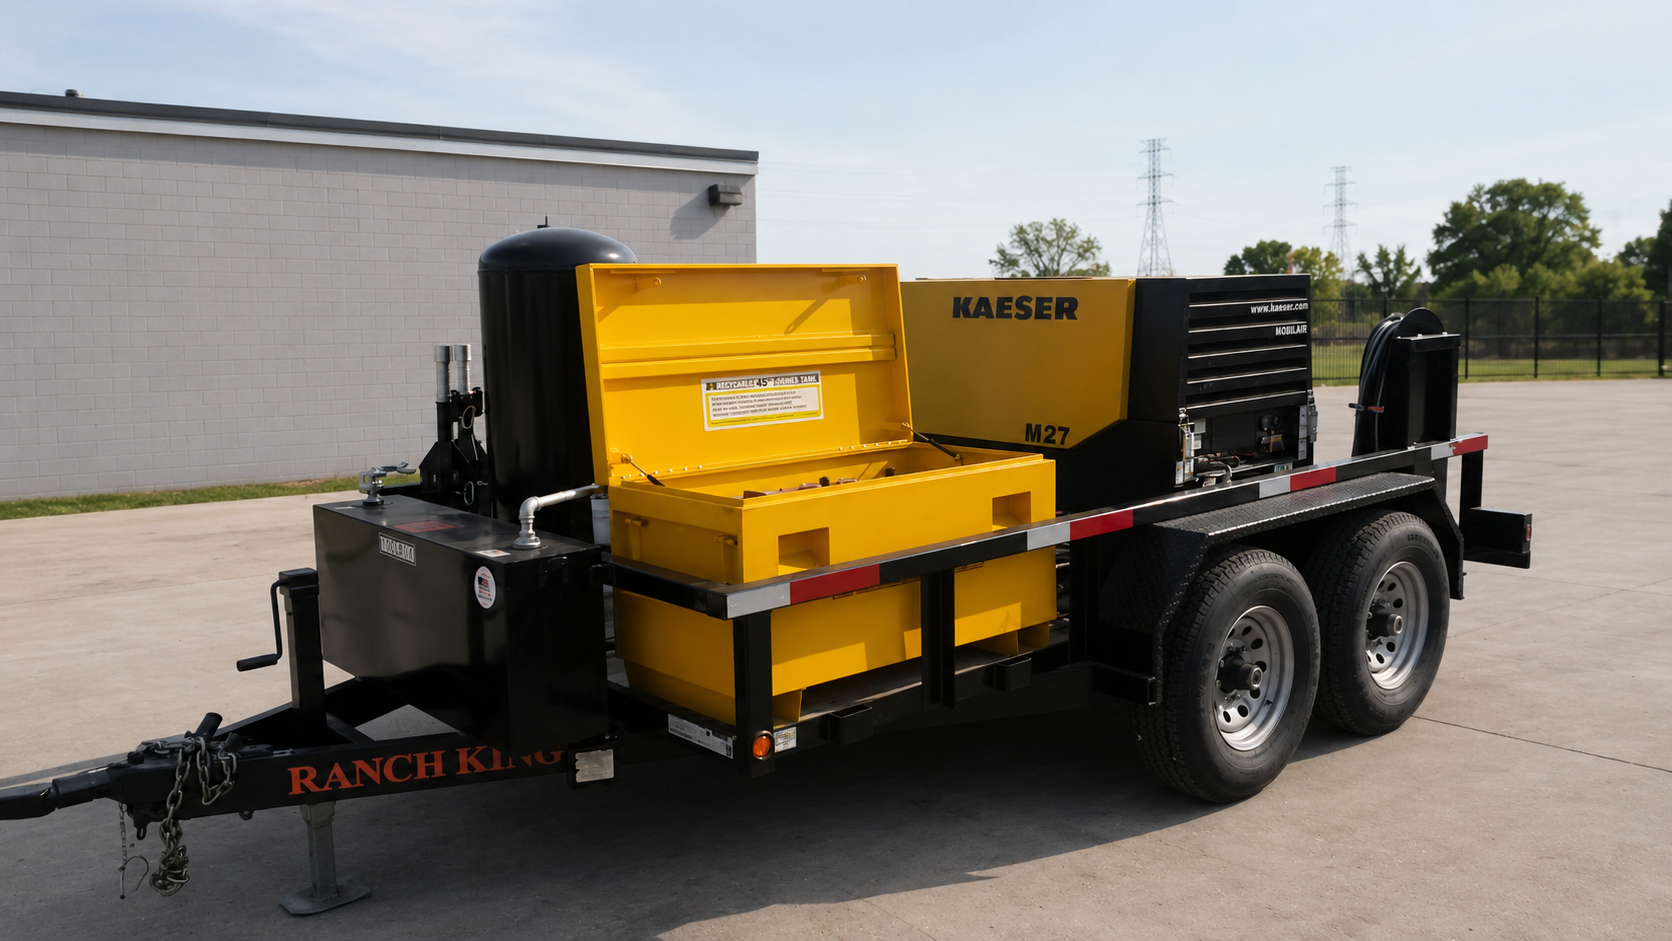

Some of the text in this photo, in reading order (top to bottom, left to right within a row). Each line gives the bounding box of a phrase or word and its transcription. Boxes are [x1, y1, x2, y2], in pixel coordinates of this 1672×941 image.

[952, 295, 1079, 321] KAESER
[1250, 302, 1308, 313] www.kaeser.com
[1025, 423, 1070, 446] M27
[287, 749, 446, 796] RANCH
